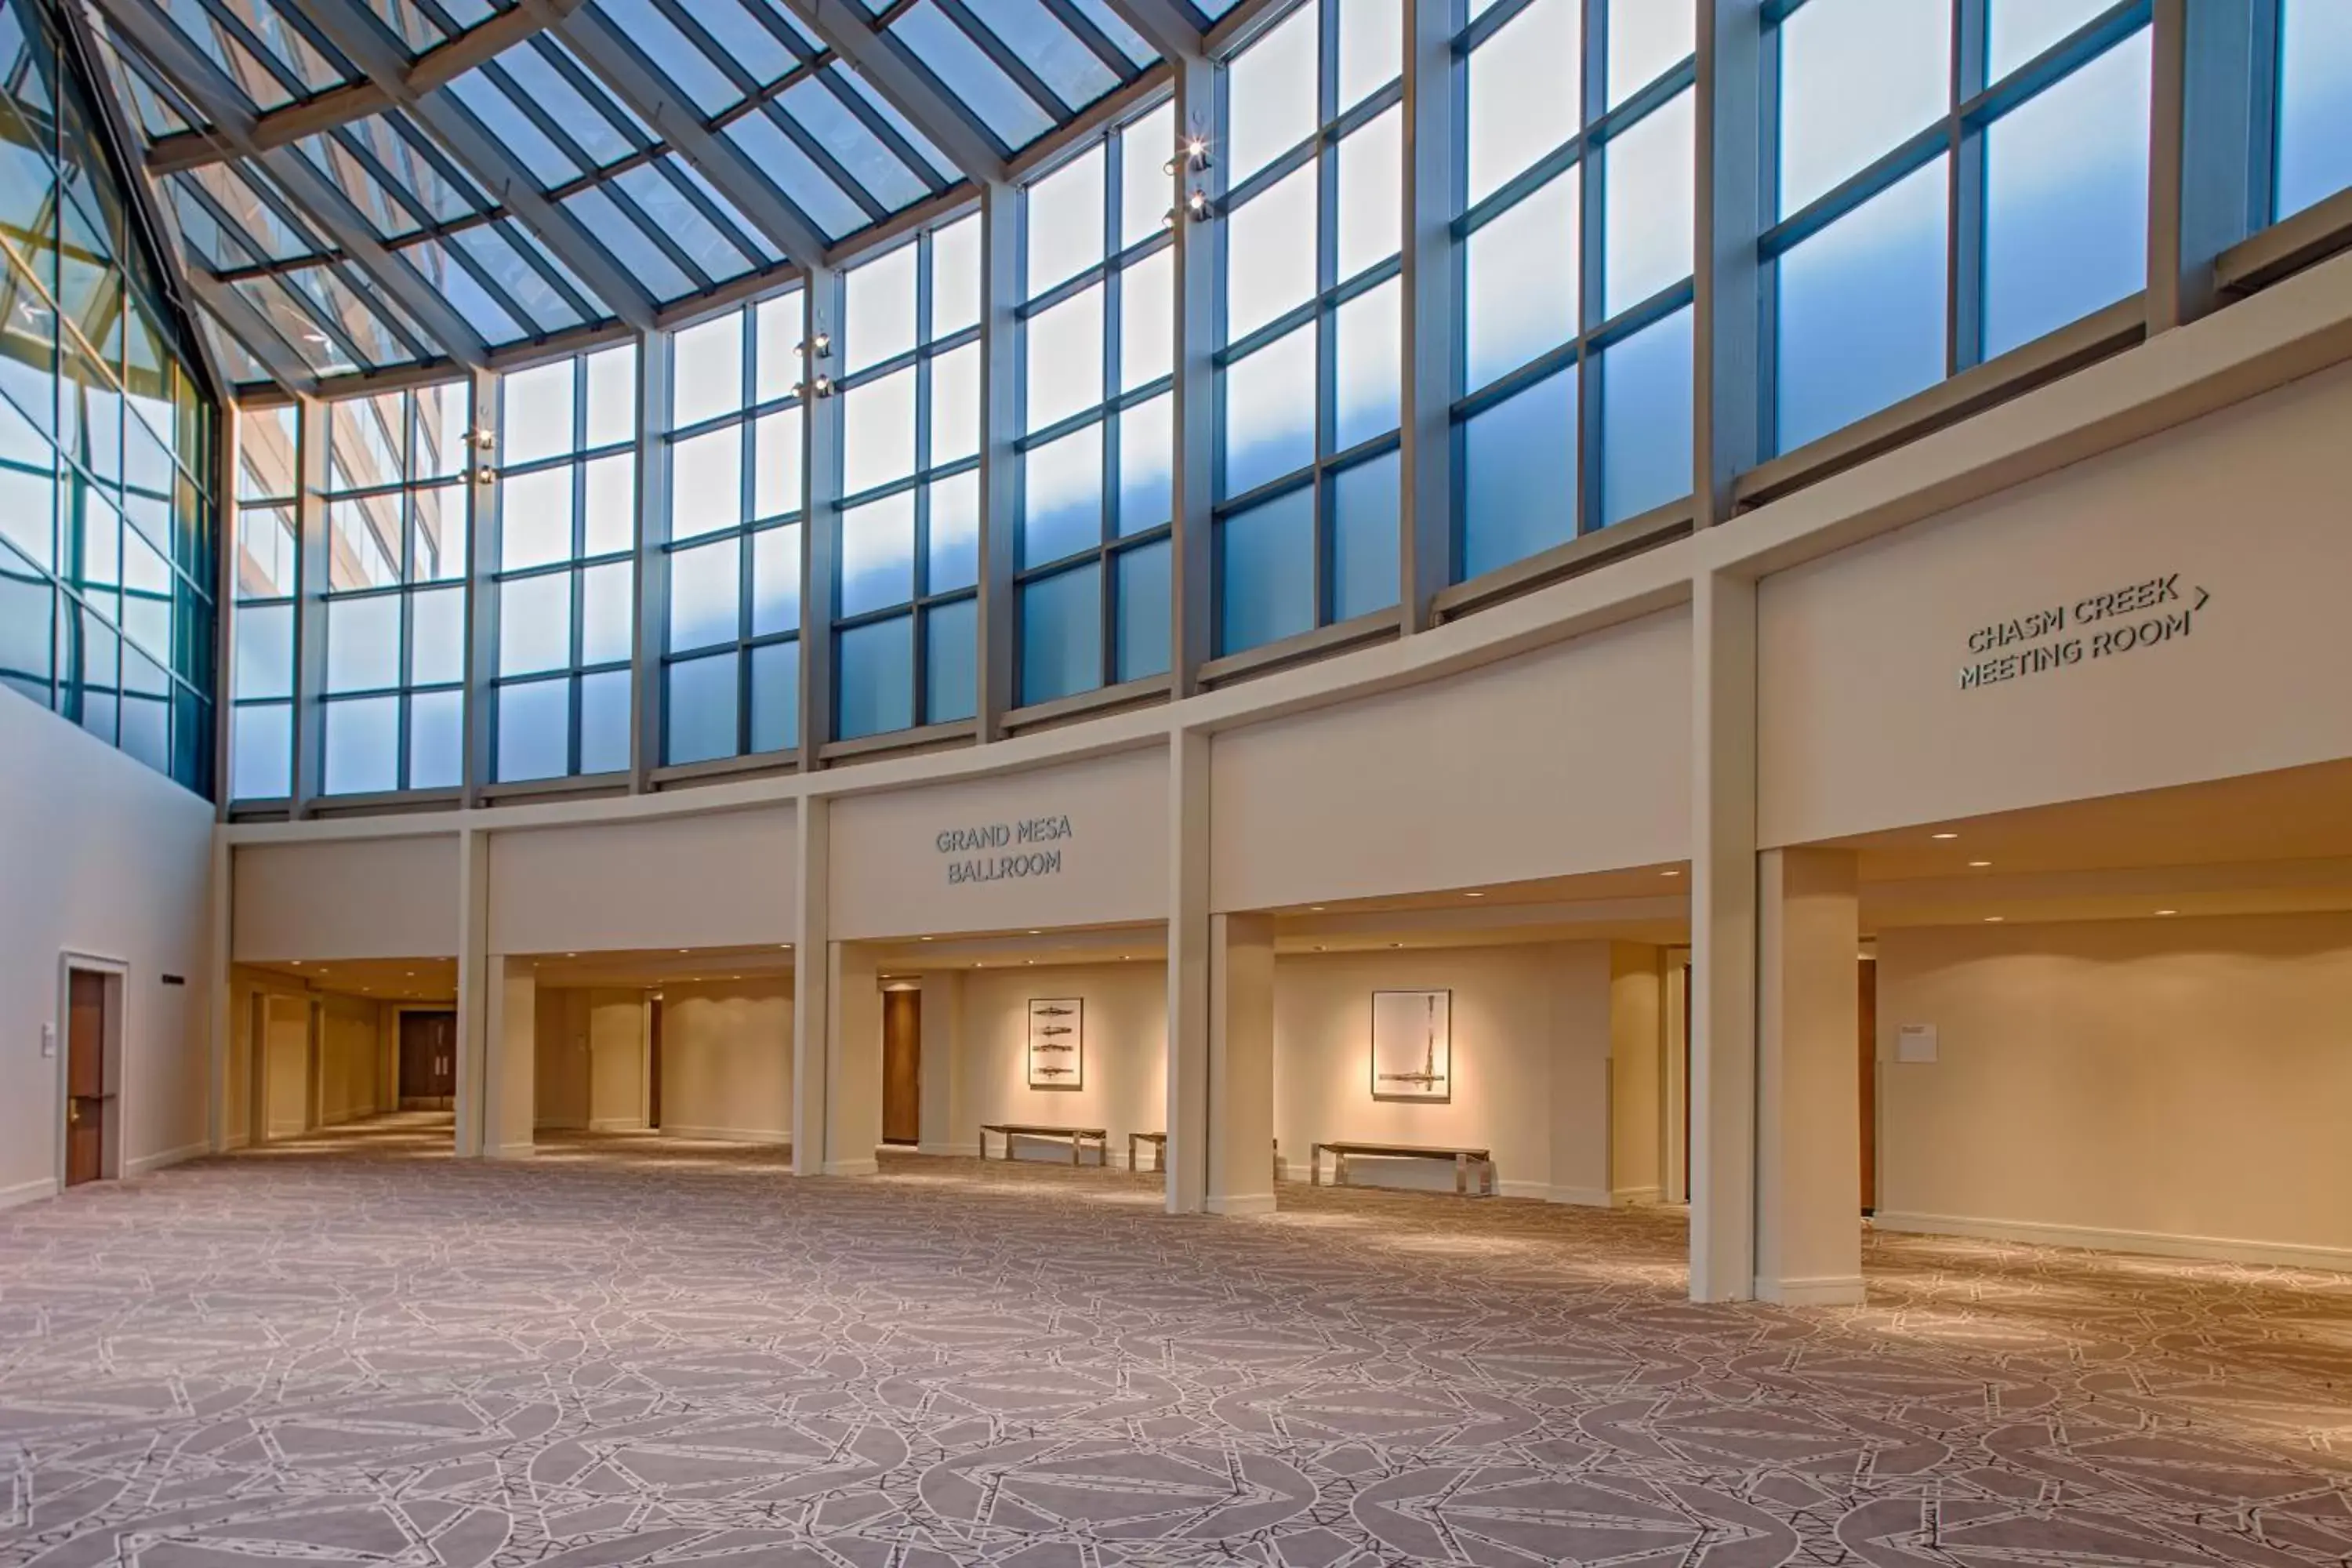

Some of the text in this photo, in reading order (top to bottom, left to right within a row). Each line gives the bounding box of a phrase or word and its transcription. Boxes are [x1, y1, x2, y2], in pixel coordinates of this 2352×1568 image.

[1968, 573, 2180, 654] CHASM CREEK
[1960, 611, 2190, 690] MEETING ROOM
[936, 815, 1072, 853] GRAND MESA
[949, 850, 1061, 884] BALLROOM
